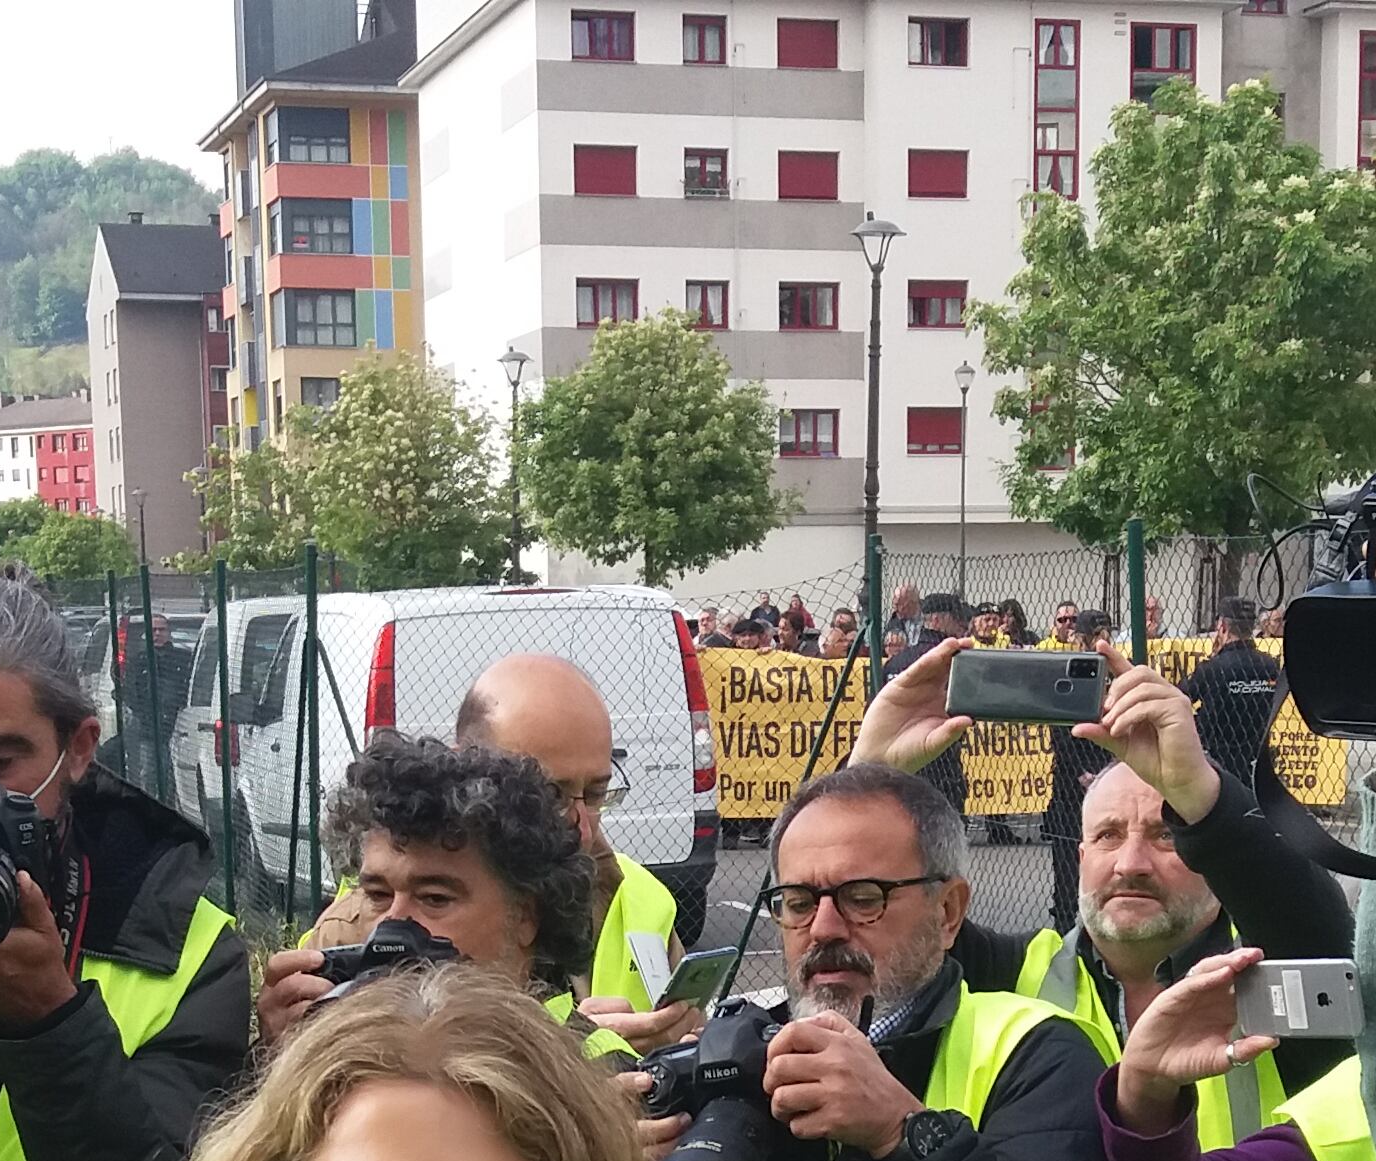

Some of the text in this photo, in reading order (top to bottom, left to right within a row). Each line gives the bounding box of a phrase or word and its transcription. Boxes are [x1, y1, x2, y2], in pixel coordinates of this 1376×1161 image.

[720, 665, 814, 713] ¡BASTA
[822, 665, 855, 702] DE
[718, 713, 781, 759] VÍAS
[790, 721, 824, 758] DE
[961, 721, 1054, 756] ANGREO
[720, 774, 757, 801] Por
[1000, 778, 1014, 805] y
[1283, 774, 1318, 790] REO
[372, 944, 405, 953] Canon
[704, 1066, 739, 1079] Nikon
